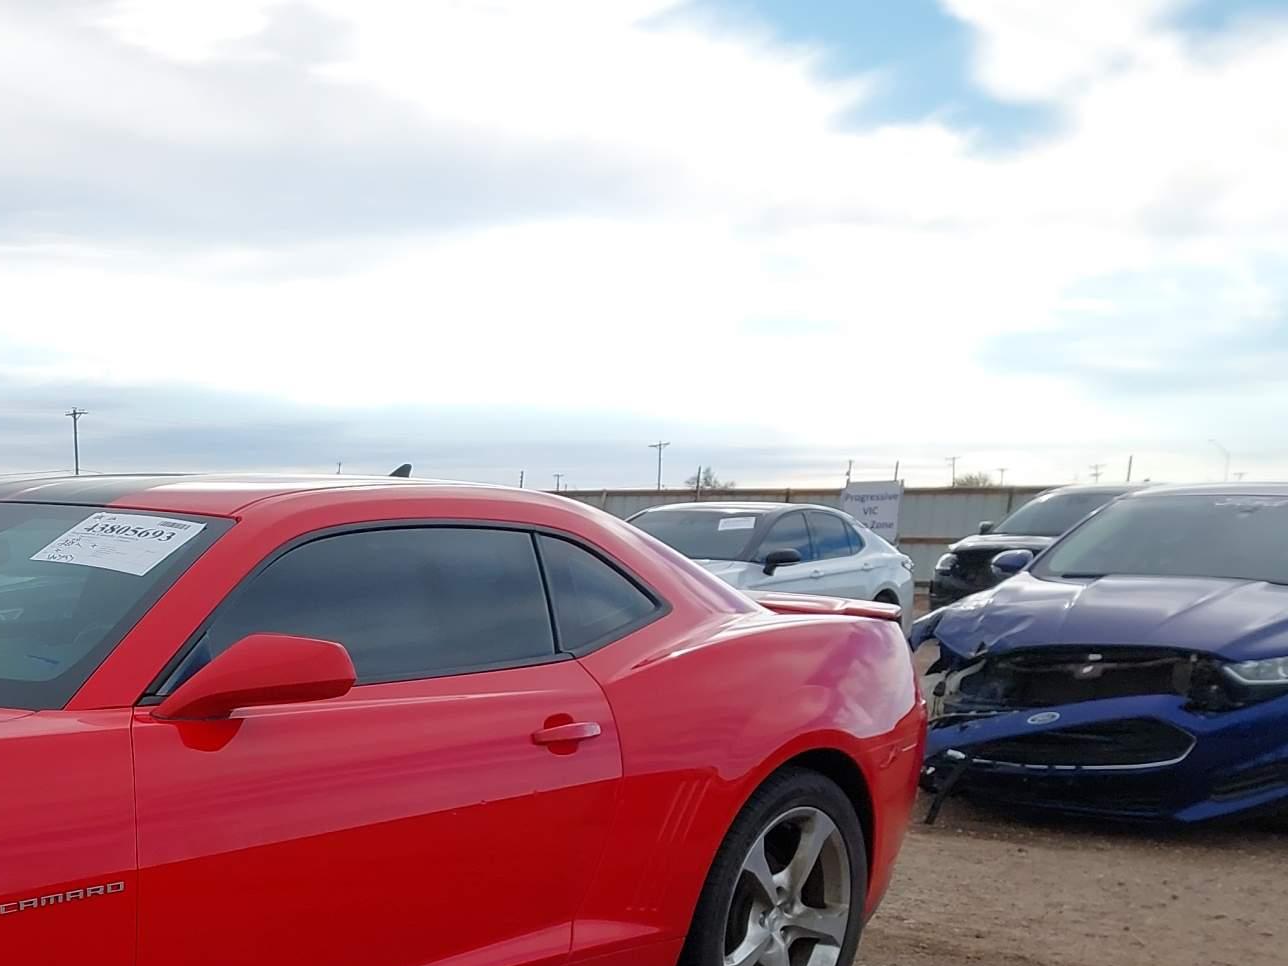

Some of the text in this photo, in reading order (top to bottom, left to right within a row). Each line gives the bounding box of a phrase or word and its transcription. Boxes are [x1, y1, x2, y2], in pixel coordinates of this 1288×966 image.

[845, 493, 898, 503] Progressive
[863, 506, 879, 515] VIC
[870, 520, 894, 529] Zone
[84, 522, 176, 541] 43805693
[0, 881, 124, 915] CAMARO
